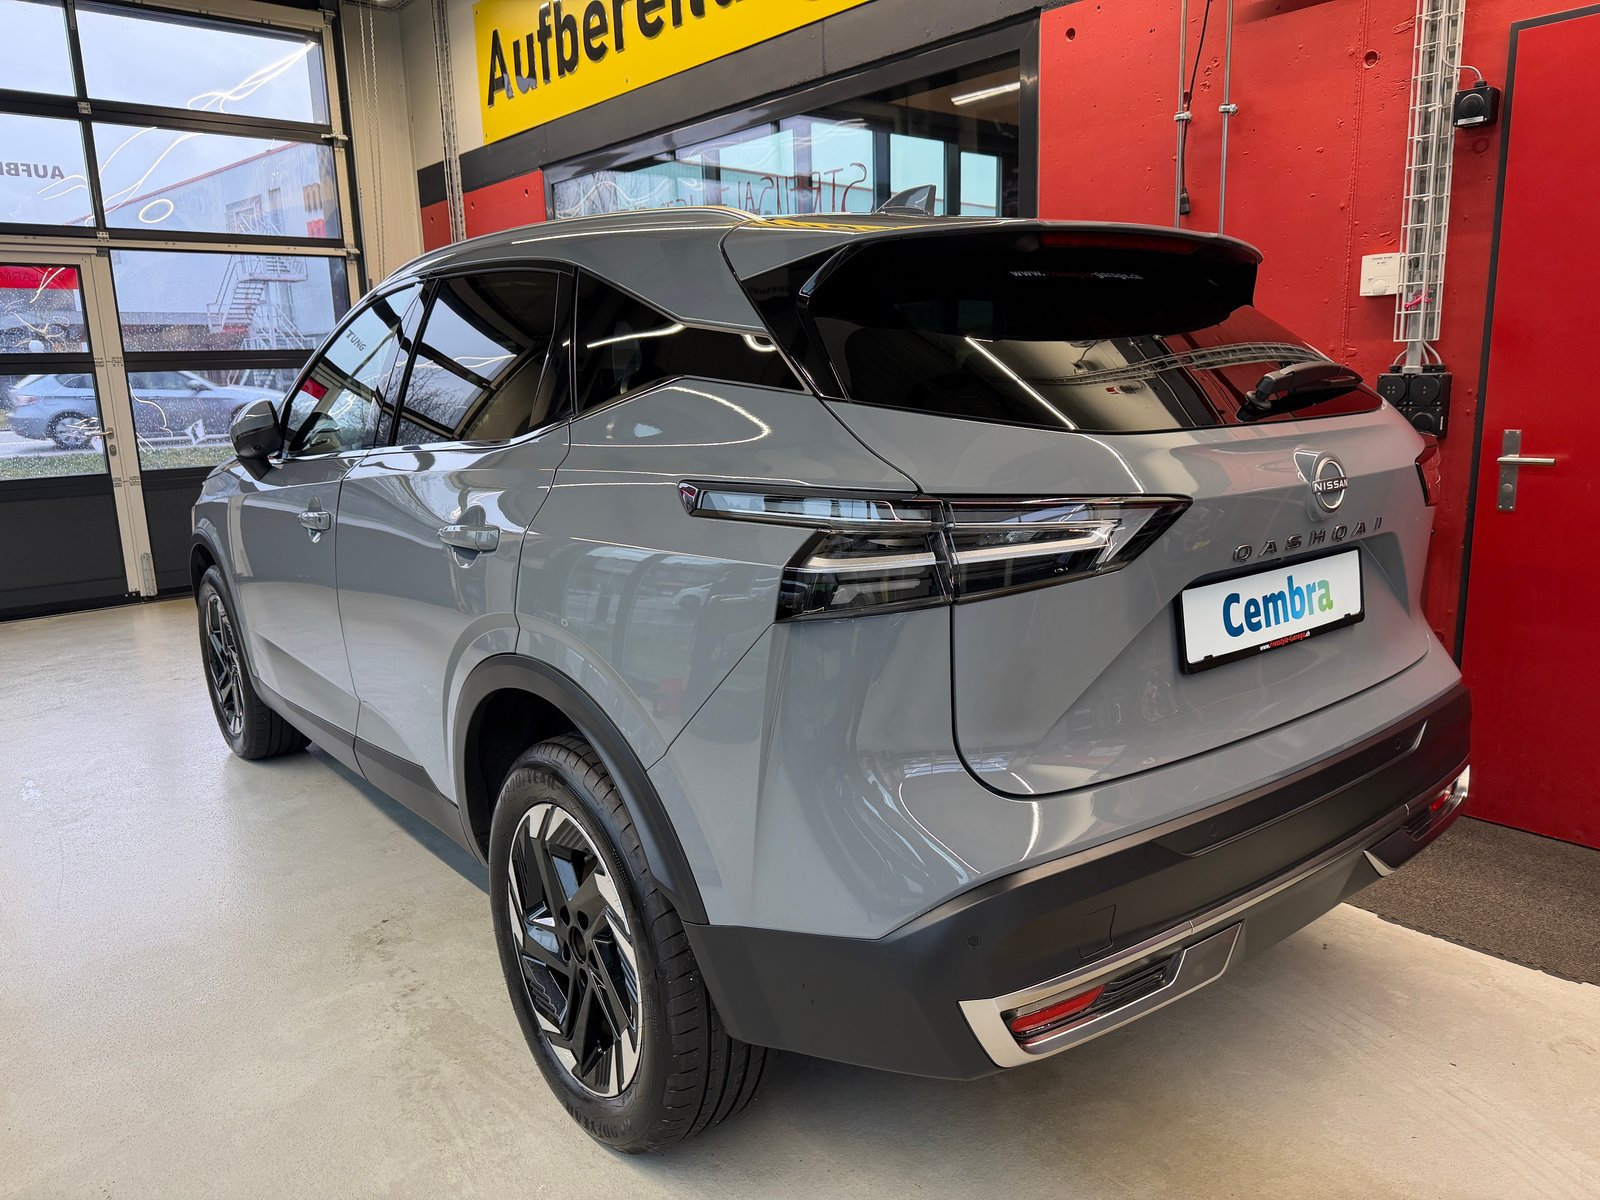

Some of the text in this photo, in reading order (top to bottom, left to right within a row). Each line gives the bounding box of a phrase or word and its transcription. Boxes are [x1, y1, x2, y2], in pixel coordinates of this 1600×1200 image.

[487, 0, 746, 108] Aufbere
[345, 328, 367, 352] TUNG
[1313, 477, 1349, 492] NISSAN
[1232, 516, 1383, 563] QASHQAI
[1222, 574, 1334, 638] Cembra
